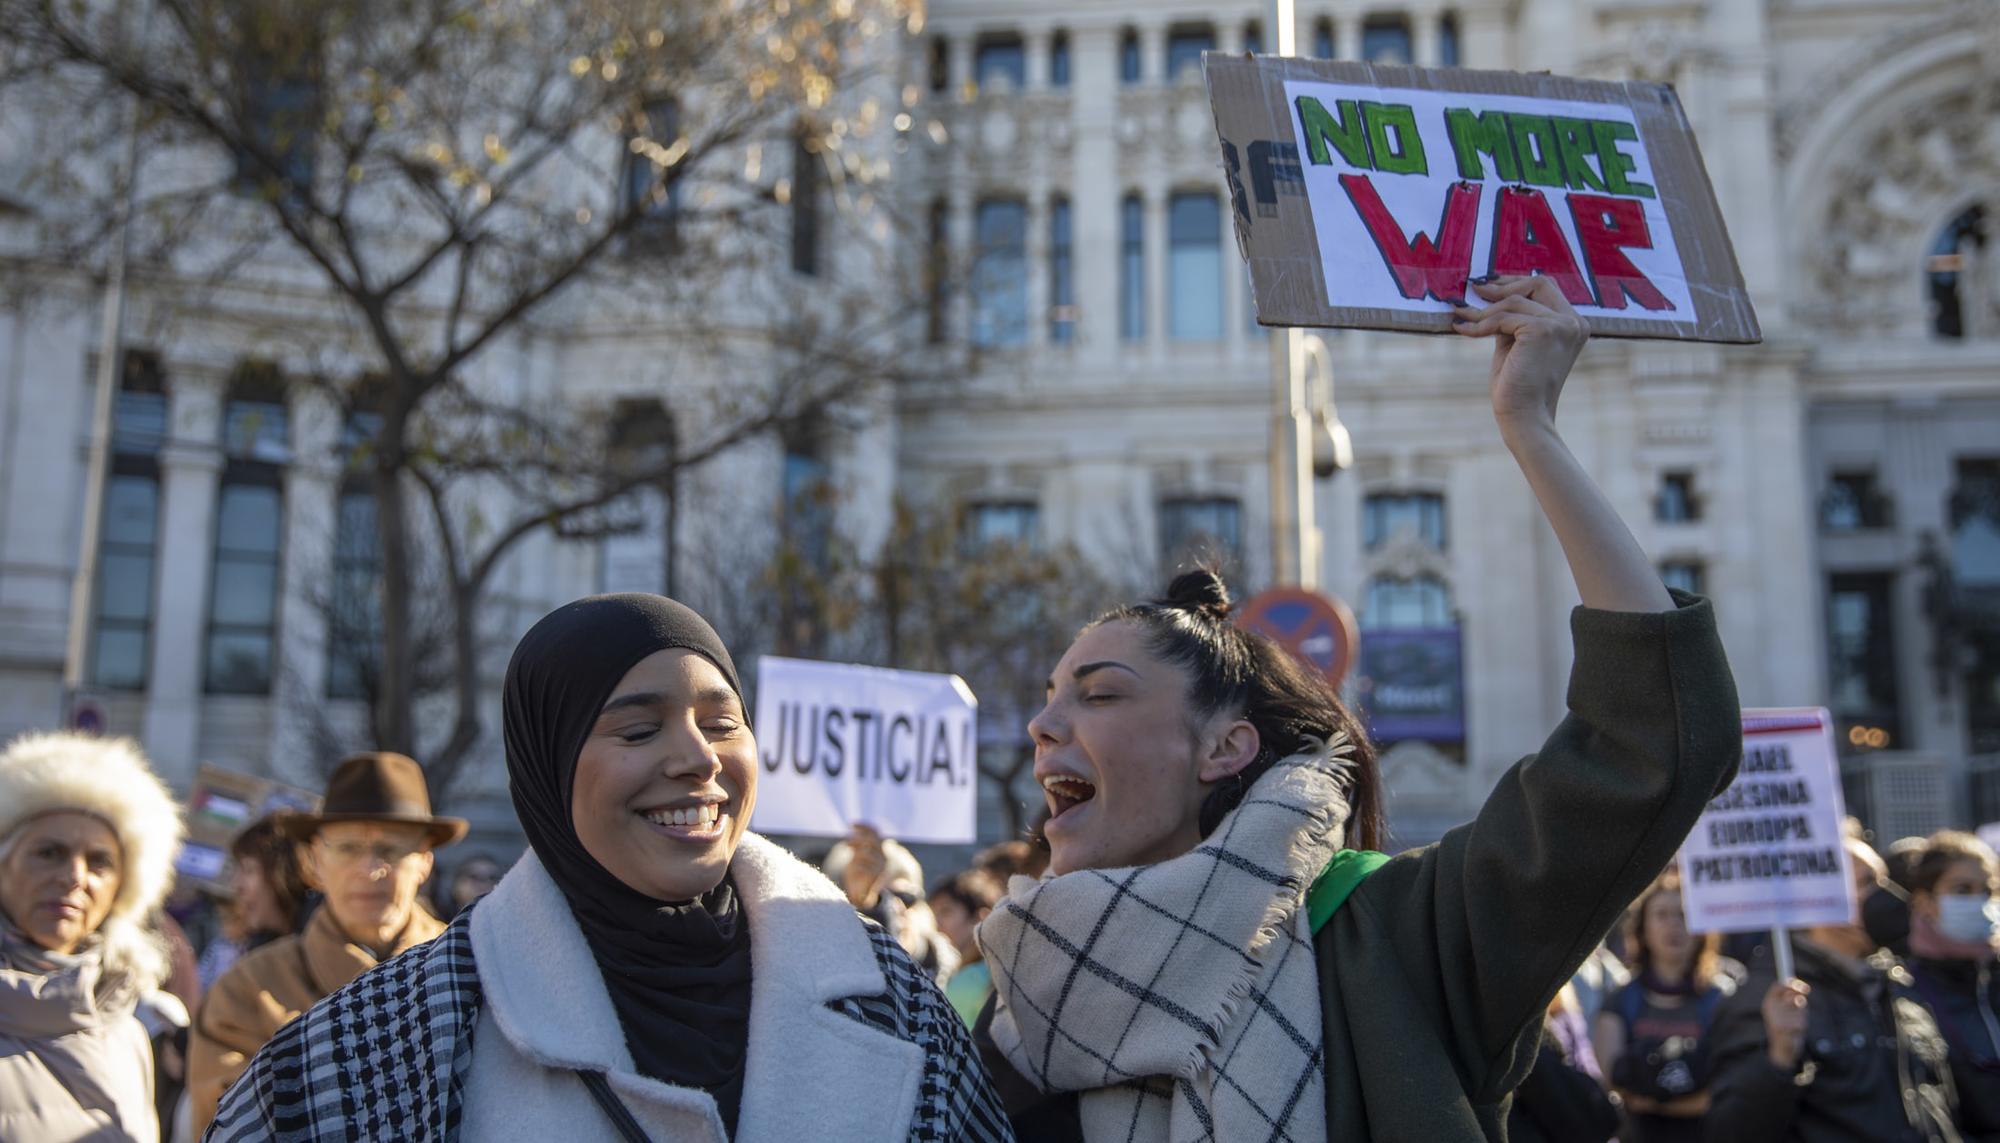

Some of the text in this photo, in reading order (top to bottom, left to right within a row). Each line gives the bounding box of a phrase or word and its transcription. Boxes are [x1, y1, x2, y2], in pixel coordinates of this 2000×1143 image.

[1294, 96, 1656, 199] NO MORE
[1337, 173, 1676, 312] WAR
[763, 702, 969, 786] JUSTICIA!
[1741, 744, 1792, 773] AEL
[1708, 815, 1811, 848] EUROPA
[1690, 849, 1840, 884] PATROCINA
